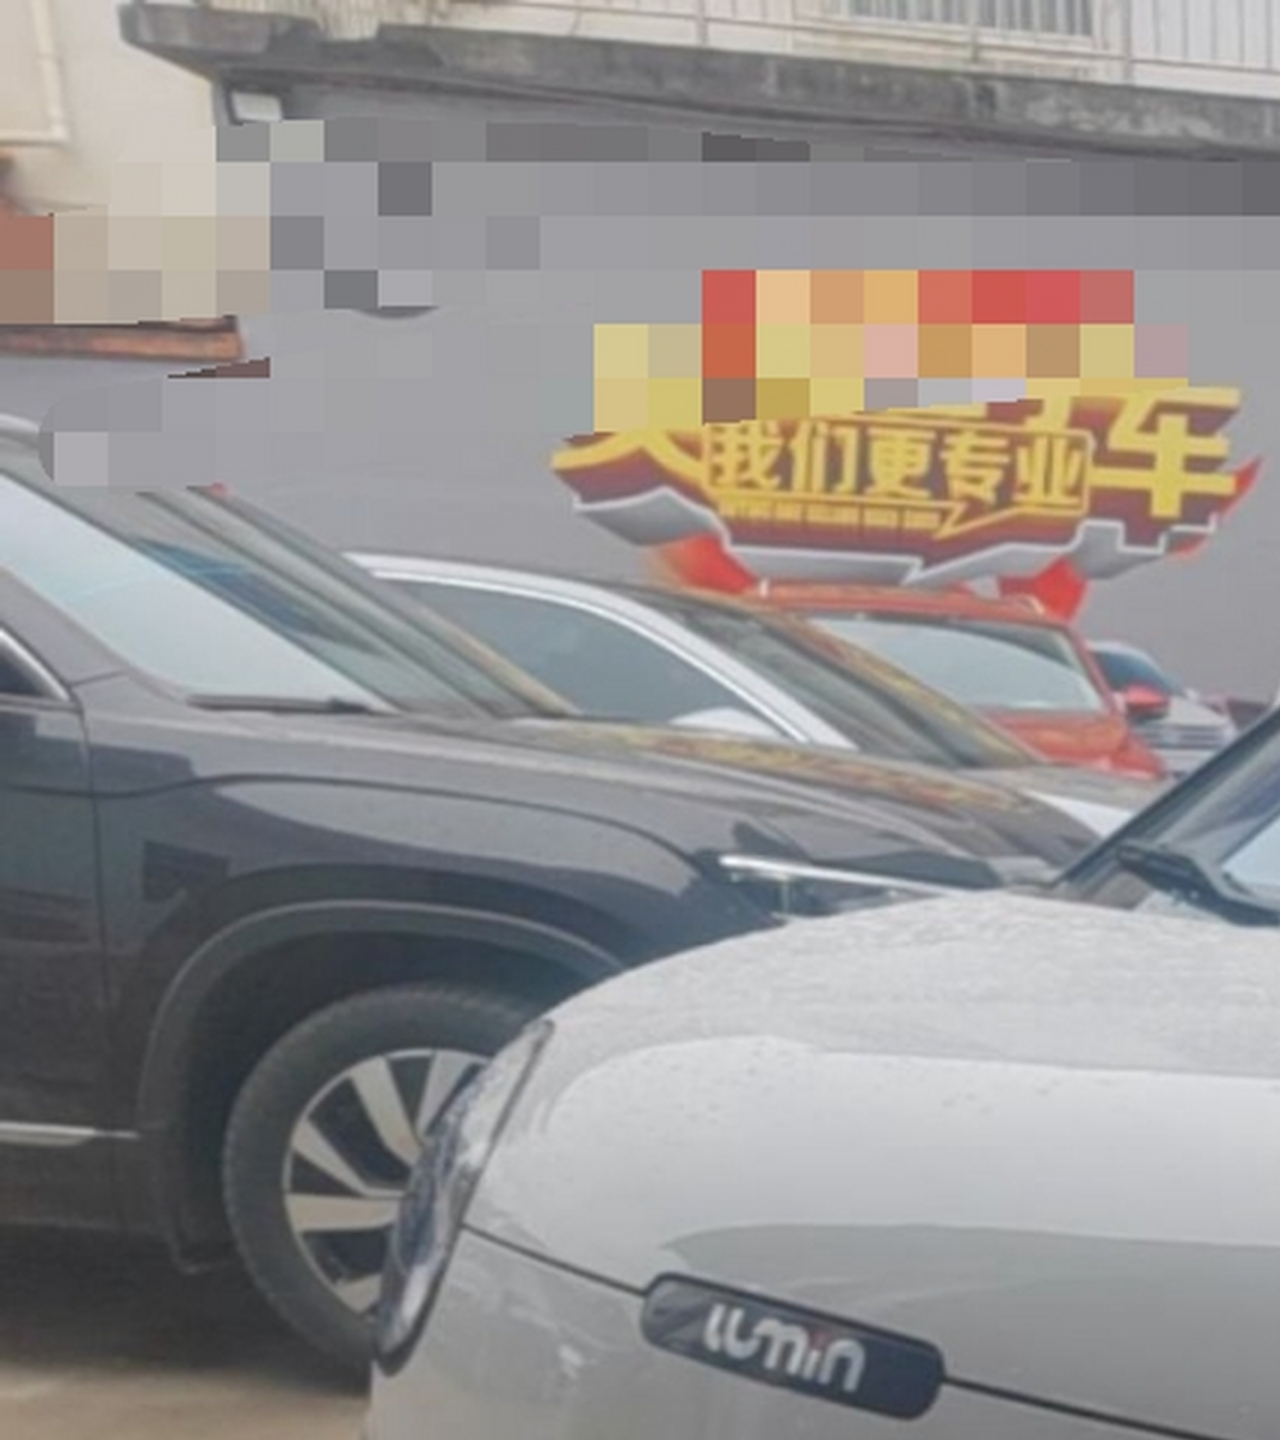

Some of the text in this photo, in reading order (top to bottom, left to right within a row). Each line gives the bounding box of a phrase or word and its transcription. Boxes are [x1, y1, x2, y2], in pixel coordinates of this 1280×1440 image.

[710, 421, 1086, 506] 我们更专业
